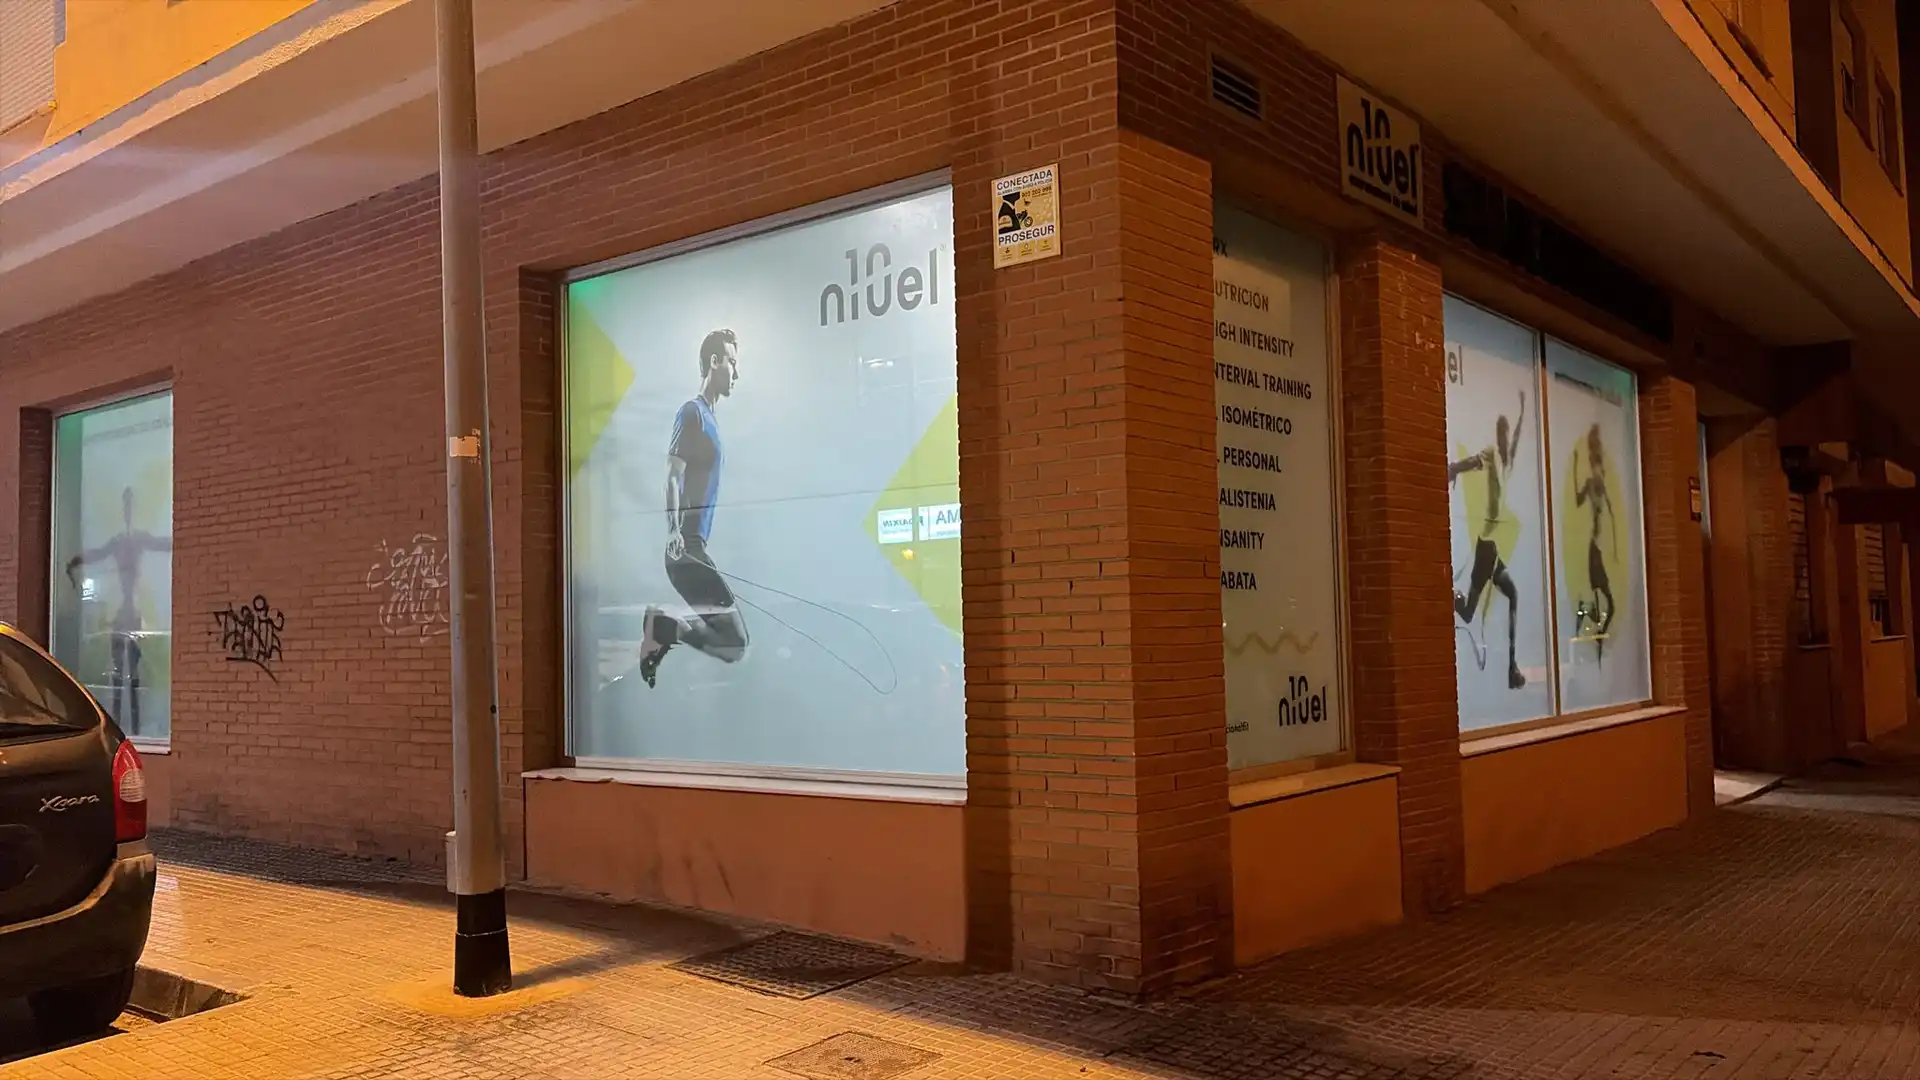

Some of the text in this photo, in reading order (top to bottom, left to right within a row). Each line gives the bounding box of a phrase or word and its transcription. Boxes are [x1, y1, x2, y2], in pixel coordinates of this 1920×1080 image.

[997, 169, 1052, 191] CONECTADA
[998, 224, 1055, 246] PROSEGUR
[845, 243, 891, 285] 10
[1215, 320, 1294, 357] IGH INTENSITY
[1262, 374, 1312, 400] TRAINING
[1221, 405, 1292, 435] ISOMÉTRICO
[1223, 446, 1282, 473] PERSONAL
[1219, 488, 1276, 511] ALISTENIA
[1221, 570, 1257, 591] ABATA
